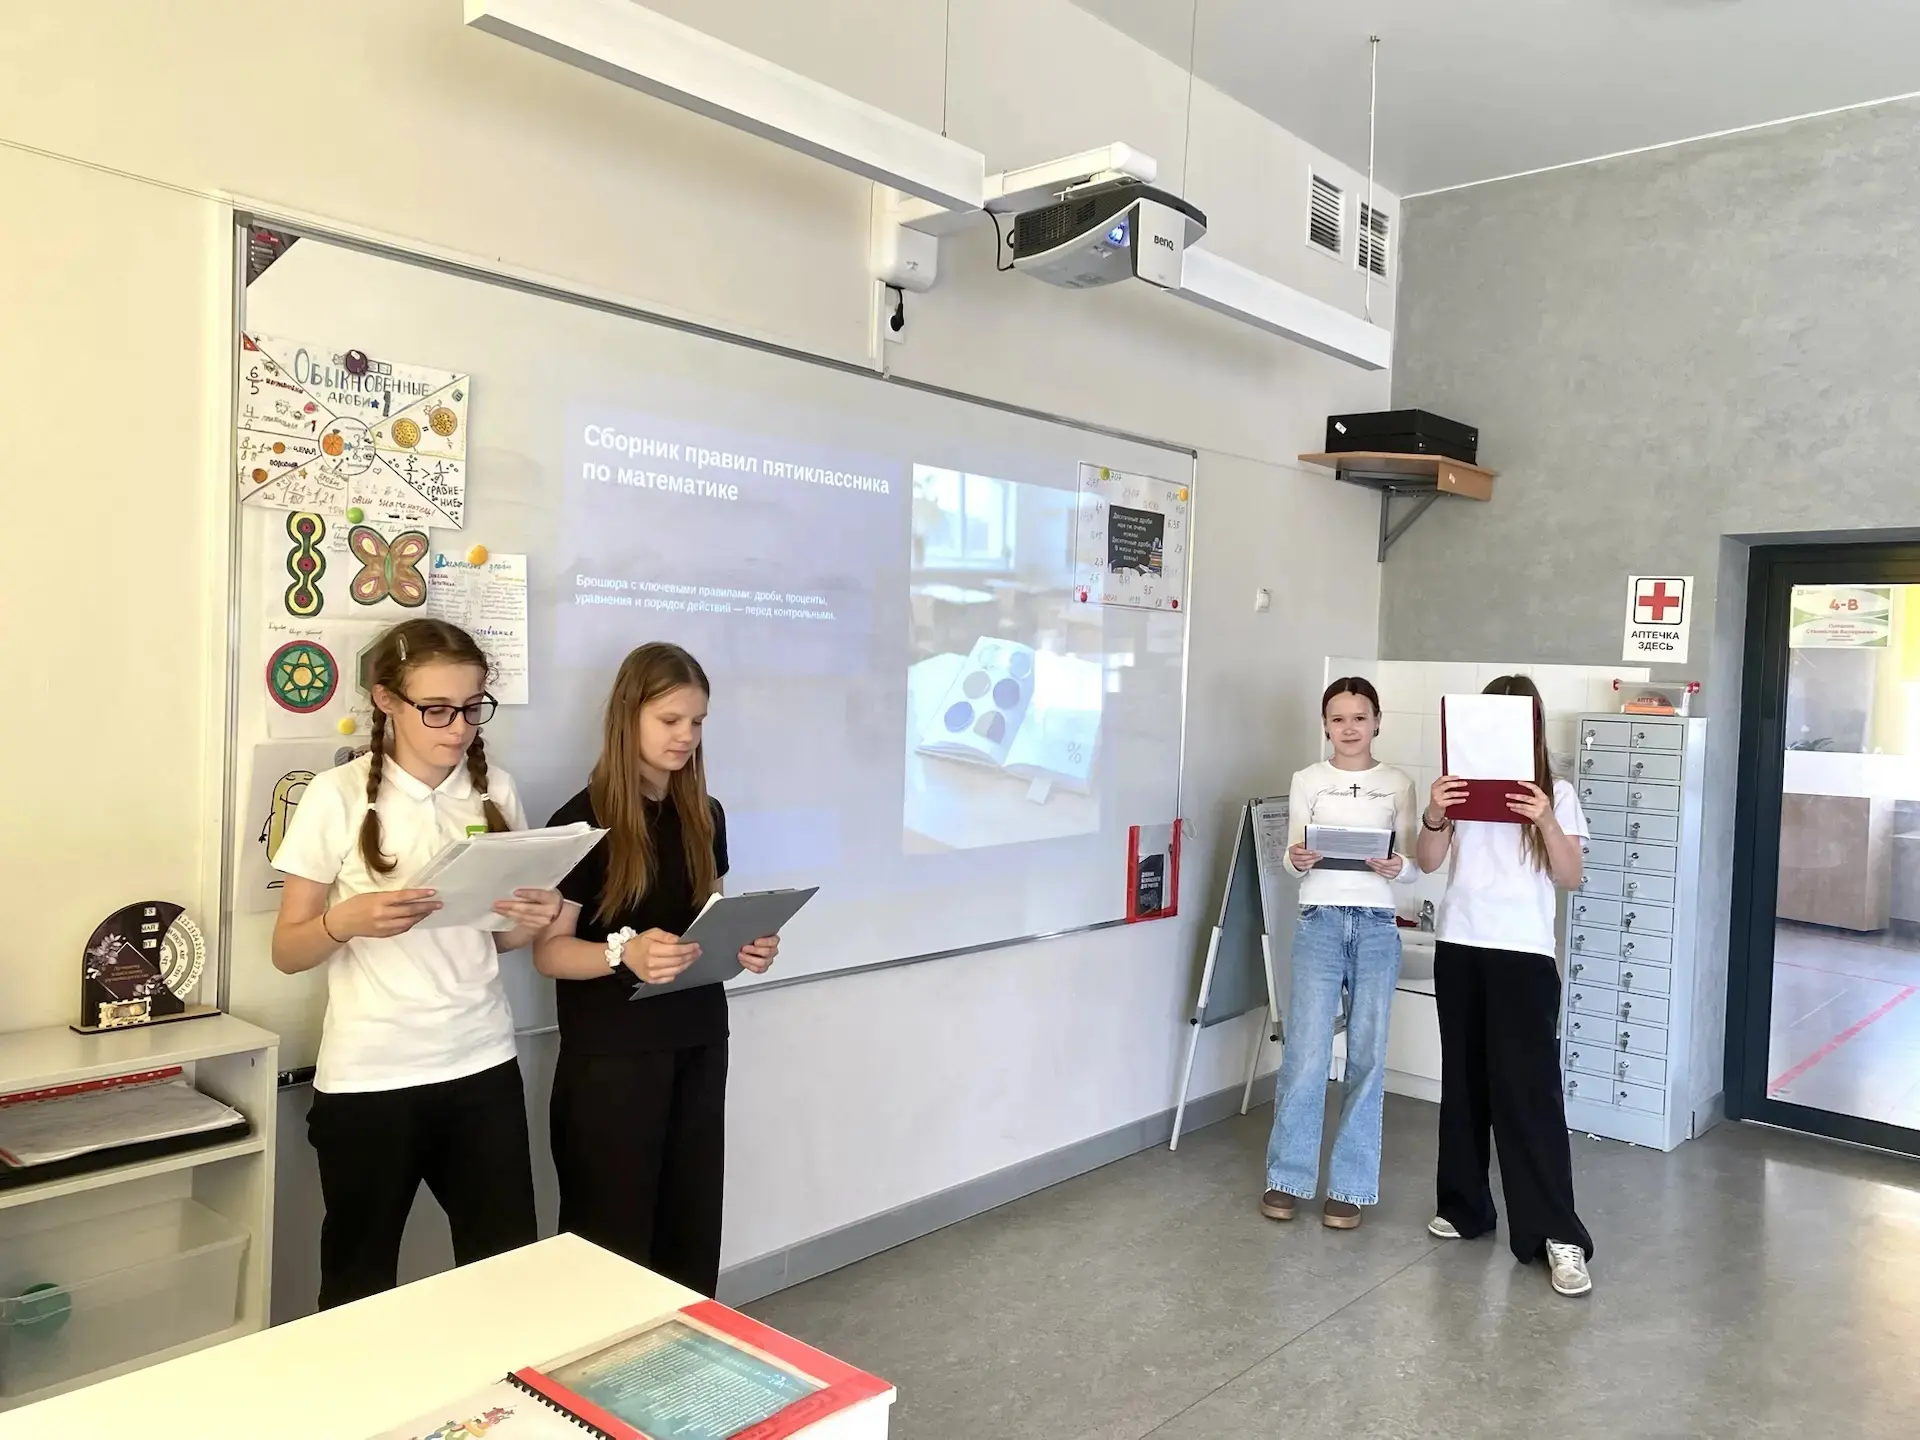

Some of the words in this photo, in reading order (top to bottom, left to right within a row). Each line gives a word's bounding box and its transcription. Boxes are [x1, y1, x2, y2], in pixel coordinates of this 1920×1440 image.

[1154, 235, 1174, 251] BenQ
[327, 391, 371, 406] ДРОБИ
[584, 424, 679, 461] Сборник
[685, 445, 757, 474] правил
[763, 458, 890, 495] пятиклассника
[582, 461, 610, 482] по
[617, 466, 738, 501] математике
[576, 574, 628, 591] Брошюра
[631, 581, 637, 590] с
[640, 581, 697, 596] ключевыми
[754, 589, 784, 604] дроби,
[785, 593, 828, 607] проценты,
[575, 594, 632, 609] уравнения
[635, 597, 642, 607] и
[644, 597, 685, 612] порядок
[687, 600, 731, 614] действий
[745, 606, 772, 618] перед
[774, 608, 836, 621] контрольными.
[1631, 630, 1680, 640] АПТЕЧКА
[1638, 641, 1674, 652] ЗДЕСЬ
